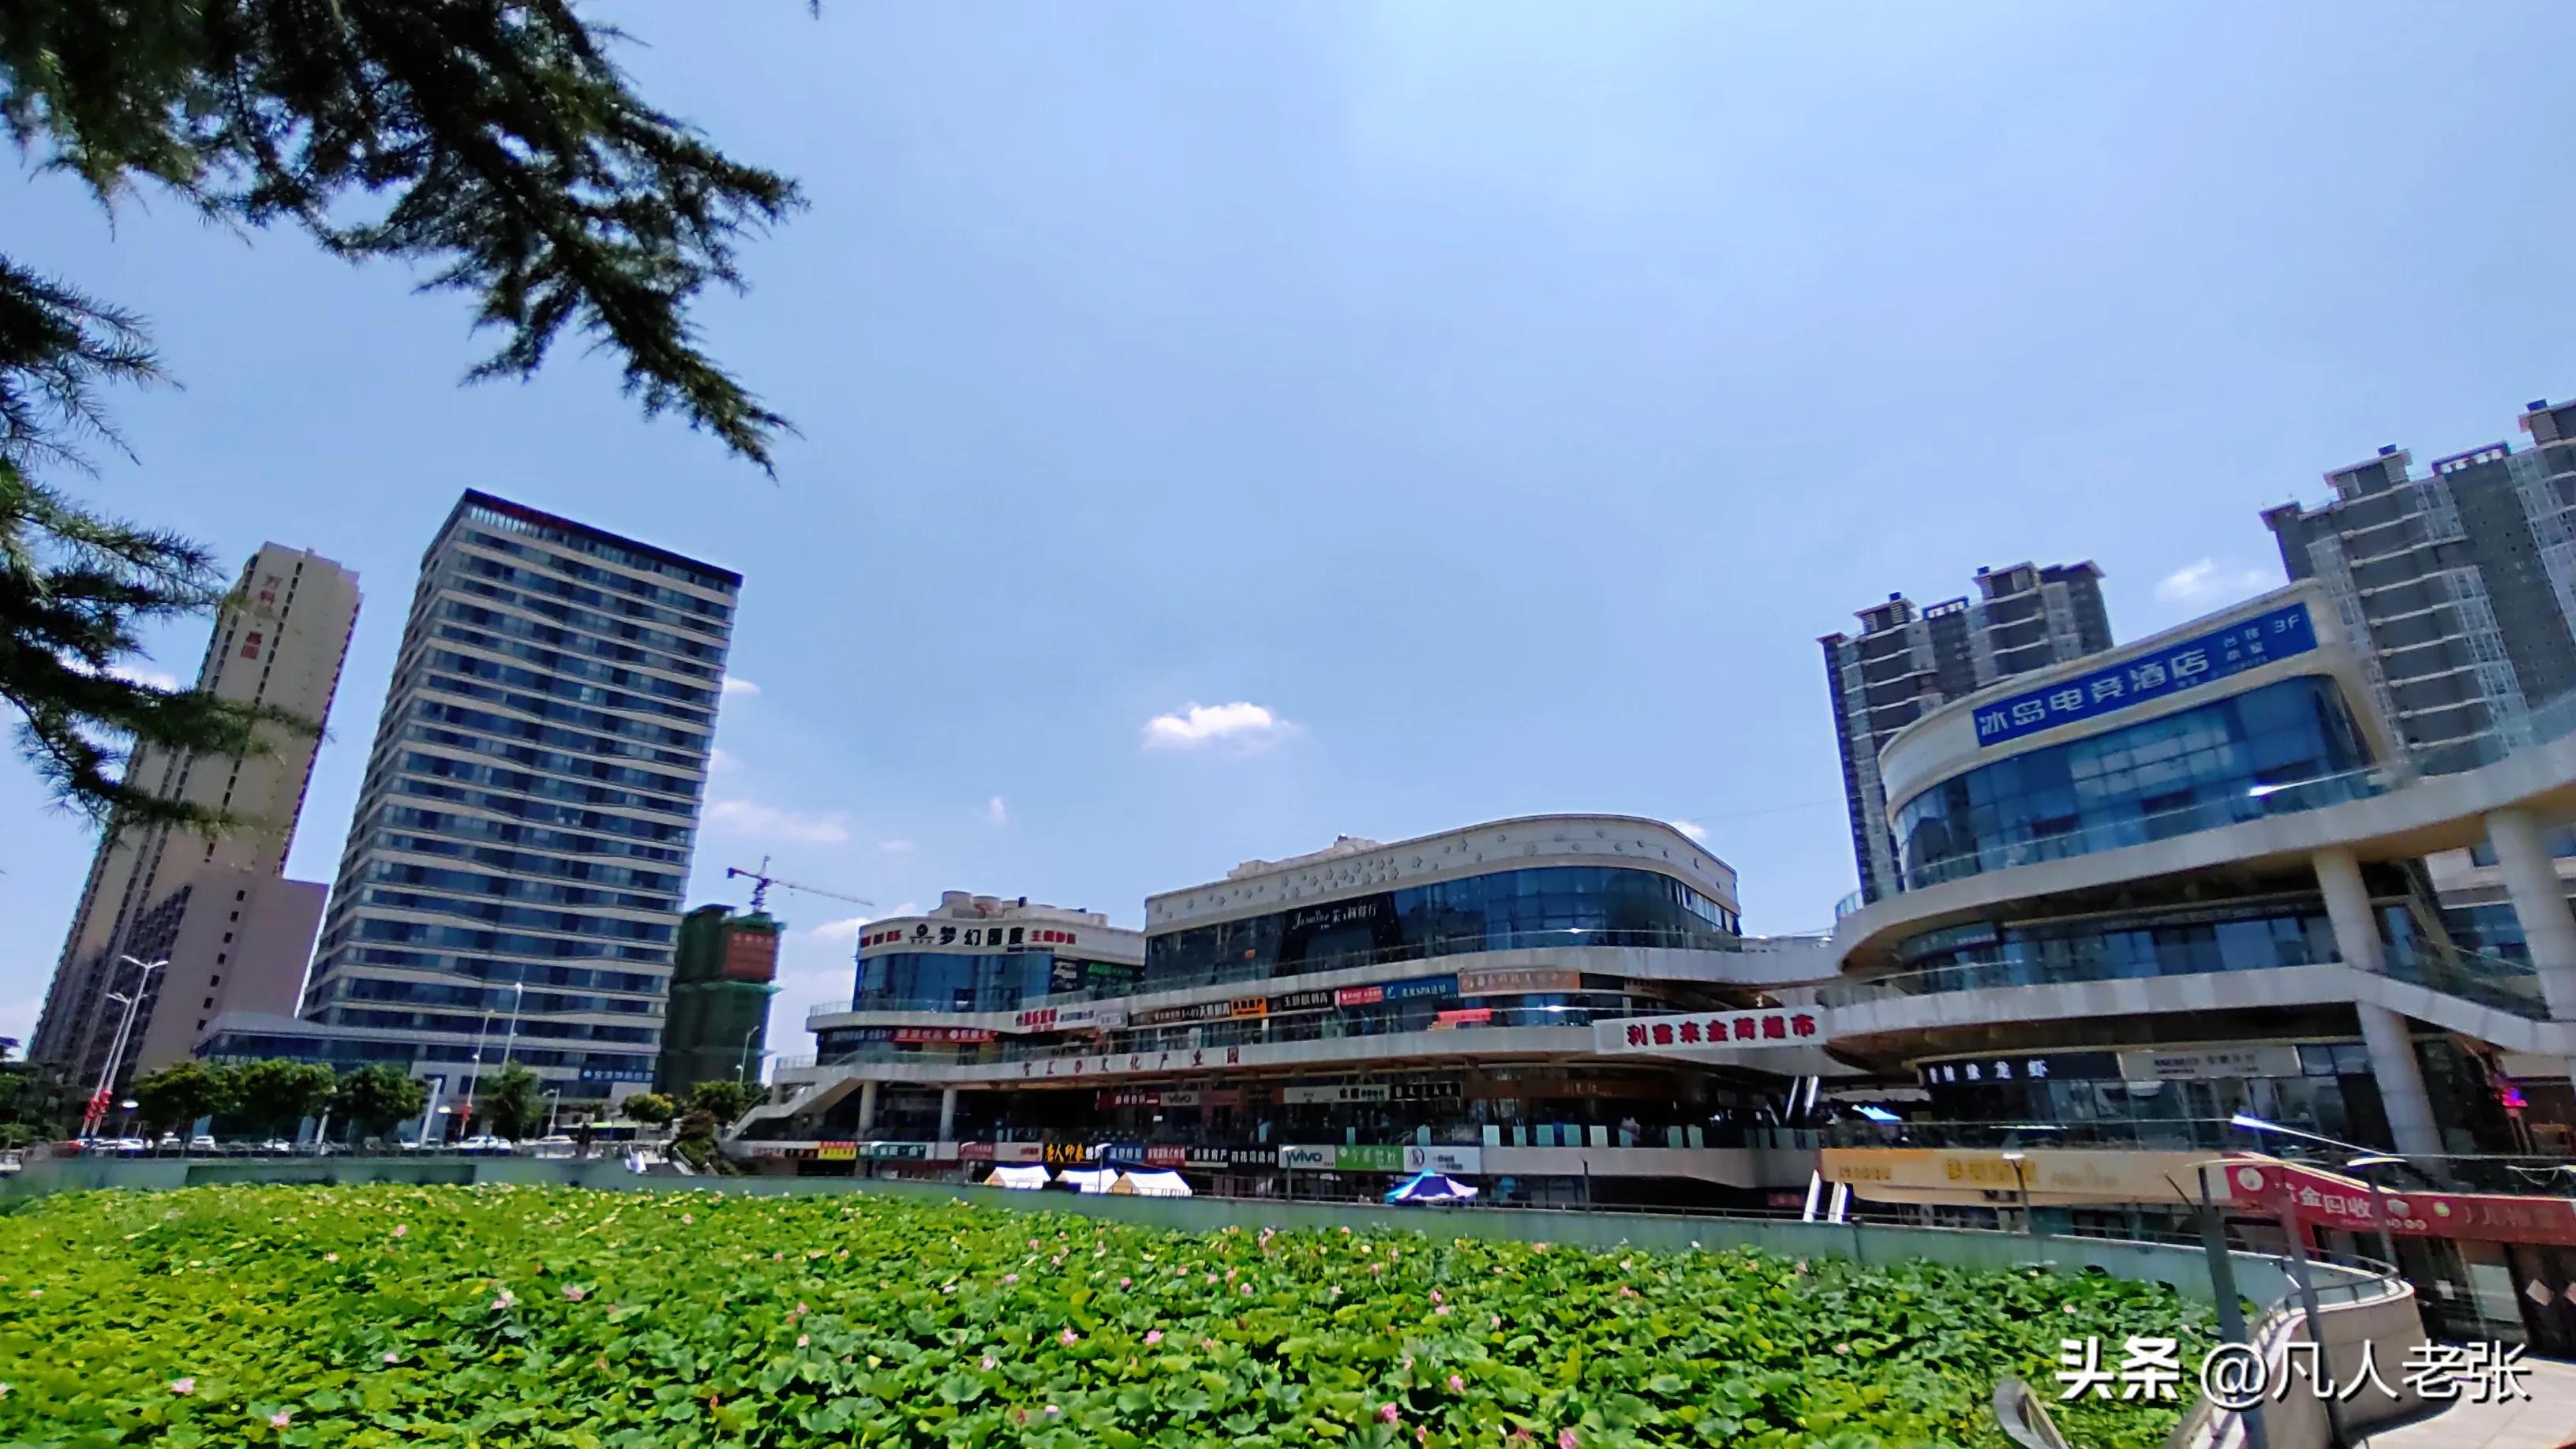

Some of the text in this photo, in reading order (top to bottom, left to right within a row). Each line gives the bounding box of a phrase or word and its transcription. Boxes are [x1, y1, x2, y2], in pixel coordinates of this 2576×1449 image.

[2272, 614, 2301, 634] 3F
[1979, 648, 2209, 736] 冰岛电竞酒店
[1168, 1092, 1192, 1103] vivo
[1291, 1148, 1323, 1162] vivo
